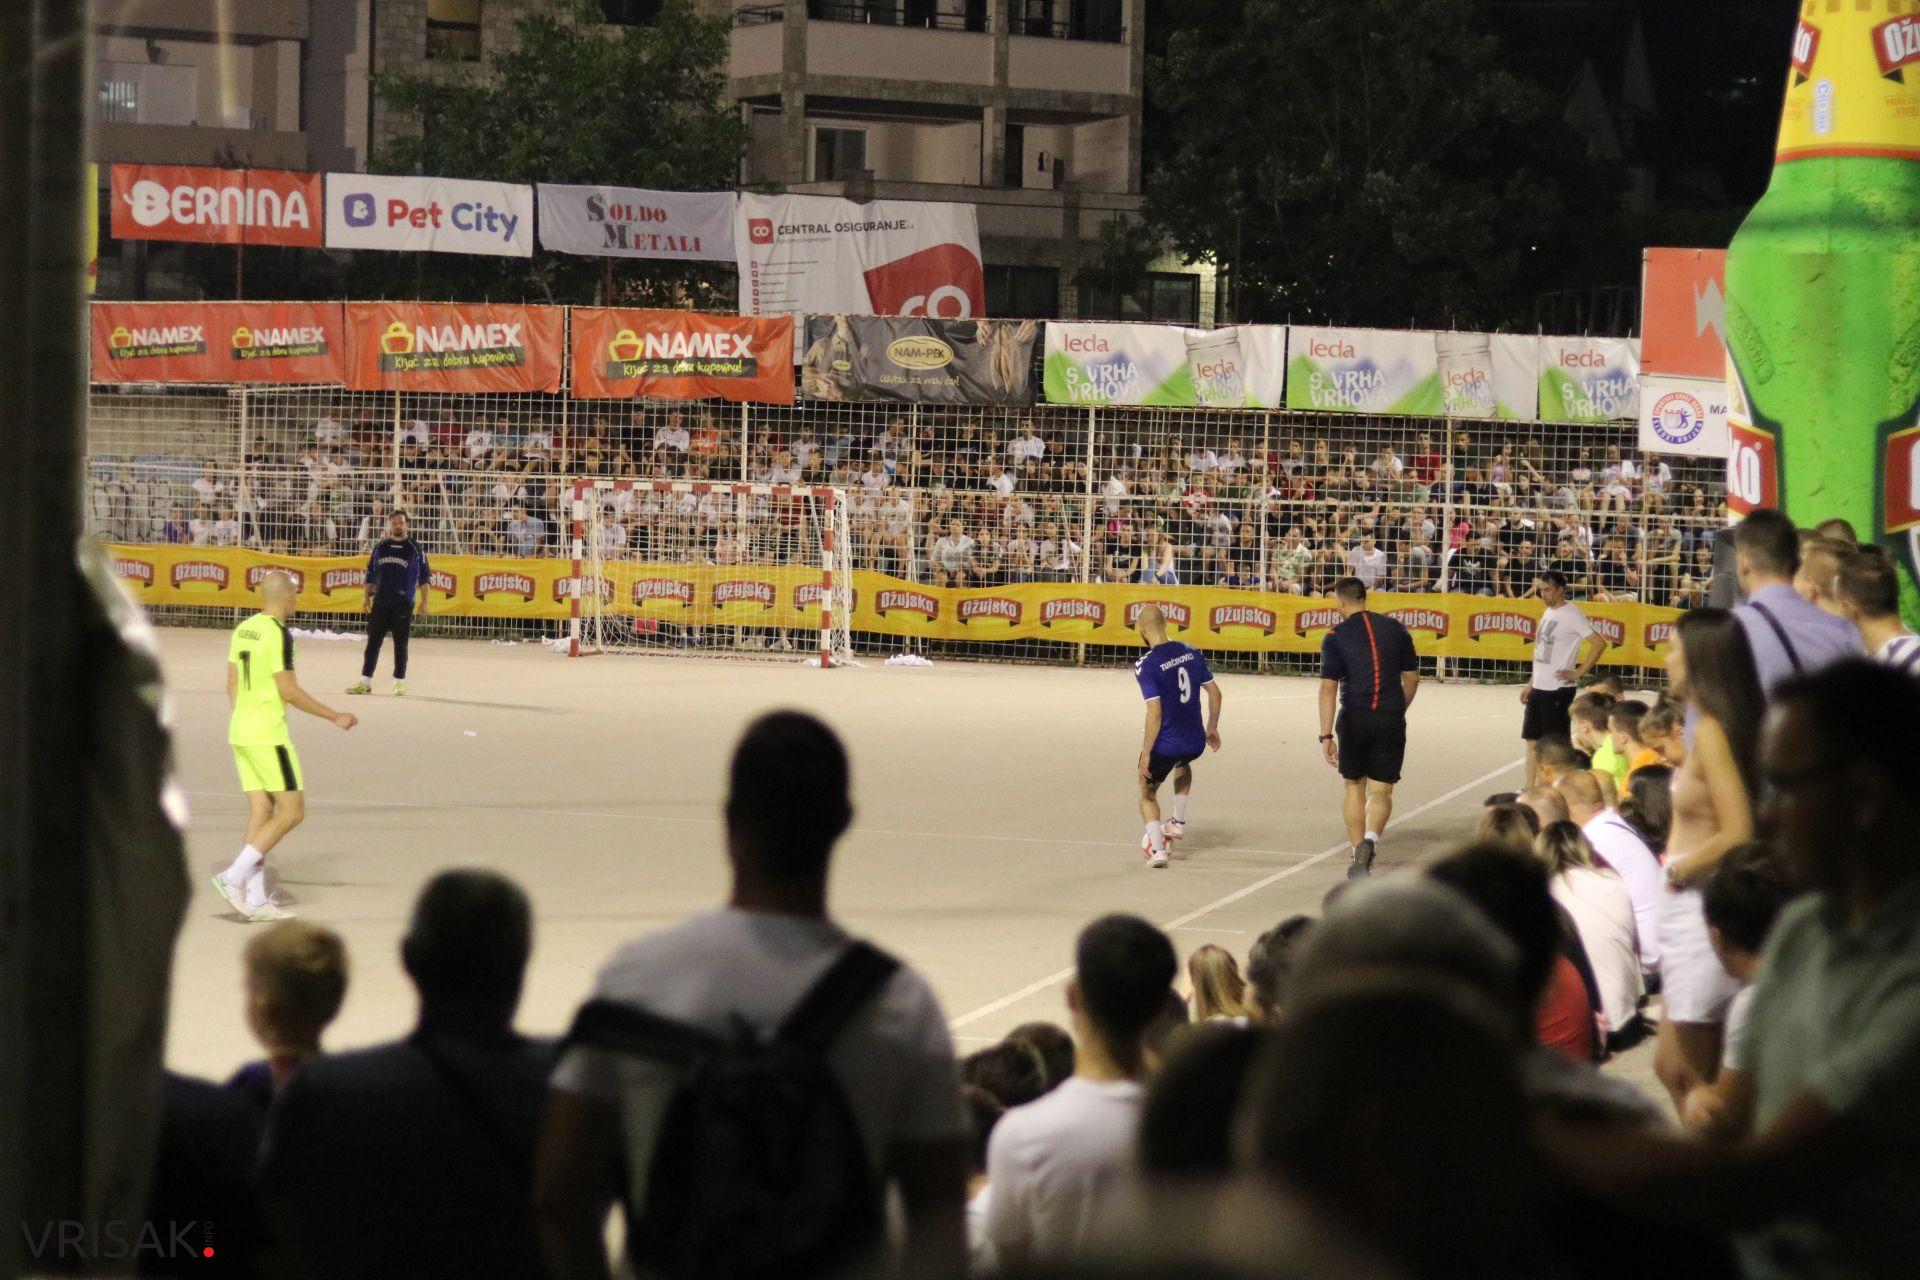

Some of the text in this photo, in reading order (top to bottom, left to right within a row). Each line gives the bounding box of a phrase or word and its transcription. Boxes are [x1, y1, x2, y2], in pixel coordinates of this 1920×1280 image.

[124, 180, 309, 228] BERNINA
[586, 193, 668, 223] SOLDO
[387, 199, 518, 242] Pet City
[778, 223, 831, 236] CENTRAL
[834, 219, 906, 233] OSIGURANJE
[133, 326, 203, 346] NAMEX
[254, 326, 325, 346] NAMEX
[416, 323, 521, 352] NAMEX
[645, 331, 754, 358] NAMEX
[1064, 334, 1109, 352] leda
[894, 347, 945, 359] NAM-PEK
[1310, 338, 1356, 359] leda
[1560, 348, 1606, 368] leda
[653, 366, 669, 374] za
[1067, 362, 1139, 384] S VRHA
[1196, 358, 1236, 379] leda
[1447, 367, 1487, 387] leda
[1310, 369, 1386, 389] S VRHA
[1561, 377, 1636, 400] S VRHA
[175, 562, 225, 581] Ožujsko
[480, 574, 530, 593] Ožujsko
[881, 590, 934, 612] Ožujsko
[962, 598, 1017, 617] Ožujsko
[1045, 599, 1101, 619] Ožujsko
[1215, 606, 1271, 626] Ožujsko
[1474, 612, 1531, 634] Ožujsko
[1178, 666, 1191, 704] 9
